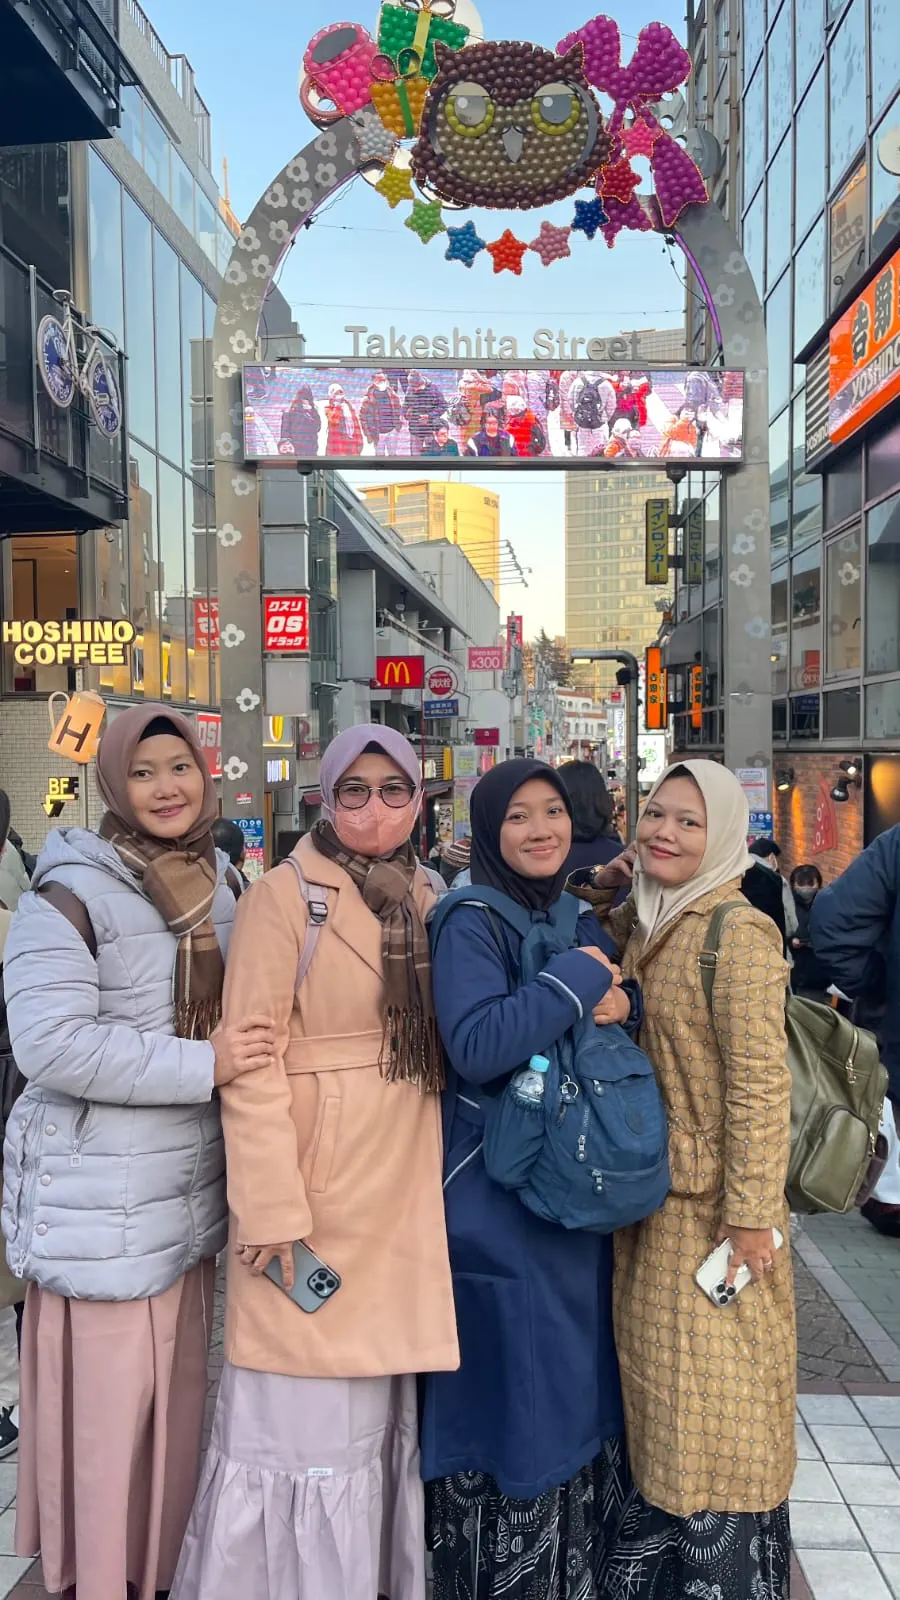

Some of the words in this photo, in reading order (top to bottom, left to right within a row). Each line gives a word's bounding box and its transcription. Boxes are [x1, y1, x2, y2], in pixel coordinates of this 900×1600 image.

[852, 264, 900, 368] 吉野
[344, 326, 518, 360] Takeshita
[533, 328, 643, 361] Street
[651, 501, 665, 573] コインロッカー
[268, 601, 302, 612] クスリ
[3, 620, 134, 643] HOSHINO
[267, 615, 304, 633] OS
[14, 643, 125, 665] COFFEE
[56, 715, 92, 752] H
